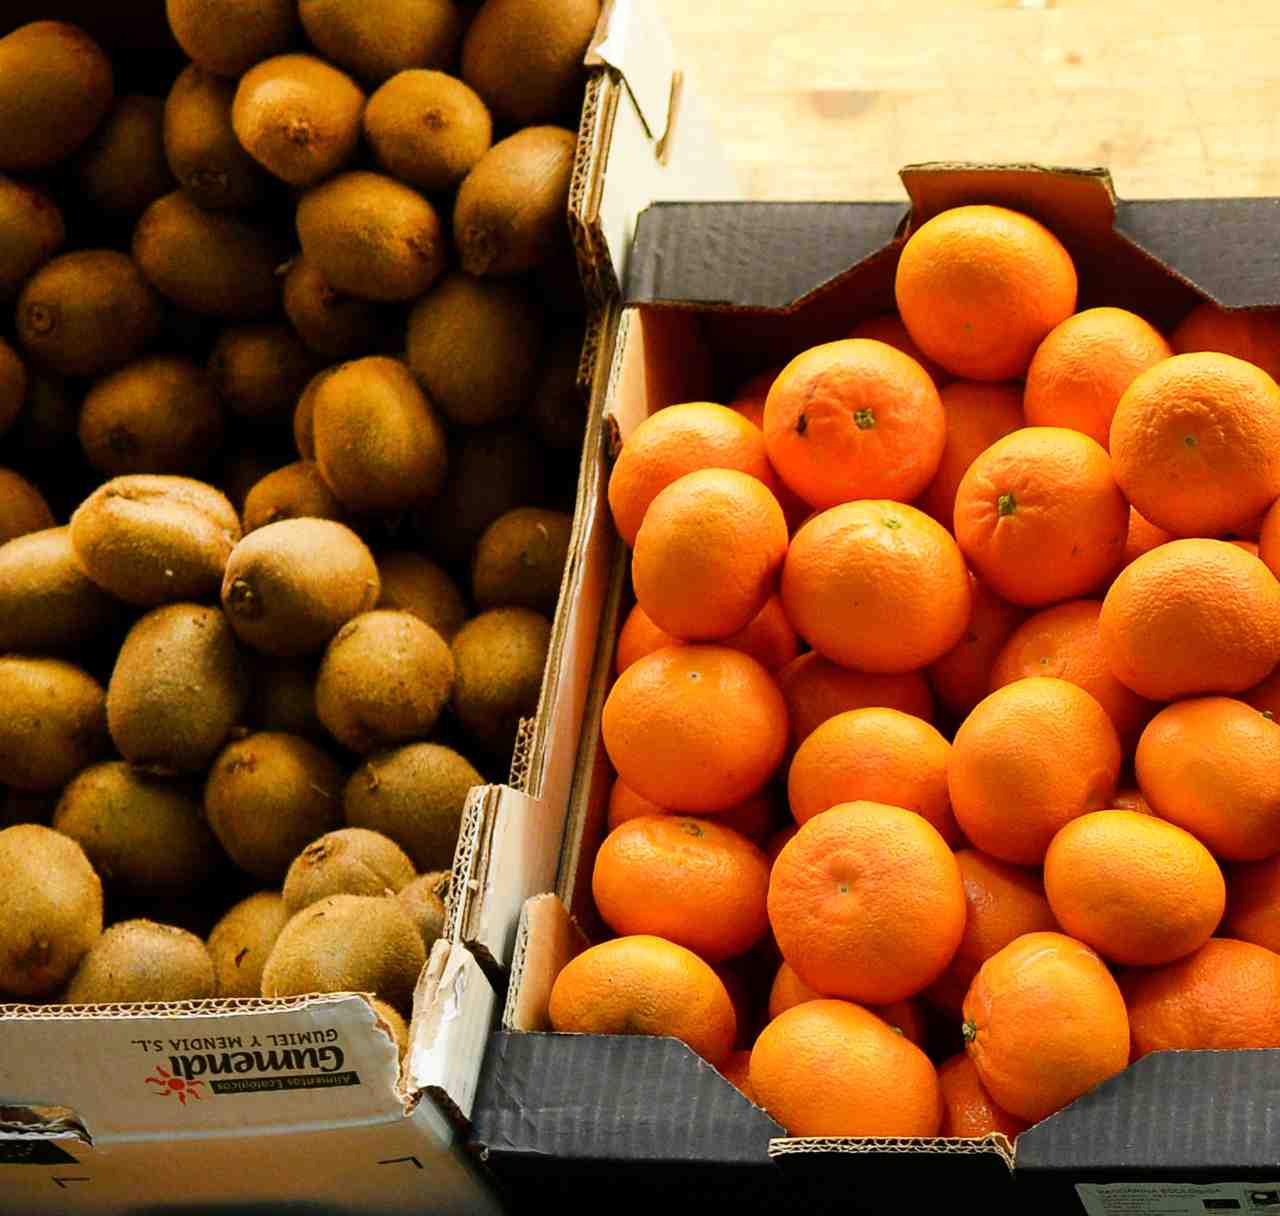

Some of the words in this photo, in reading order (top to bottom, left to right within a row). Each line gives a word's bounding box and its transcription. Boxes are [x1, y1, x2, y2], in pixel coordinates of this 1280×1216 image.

[168, 1036, 242, 1052] MENDIA
[250, 1034, 262, 1048] Y
[266, 1028, 339, 1047] GUMIEL
[131, 1039, 164, 1053] S.L.
[167, 1045, 345, 1081] Gumendi
